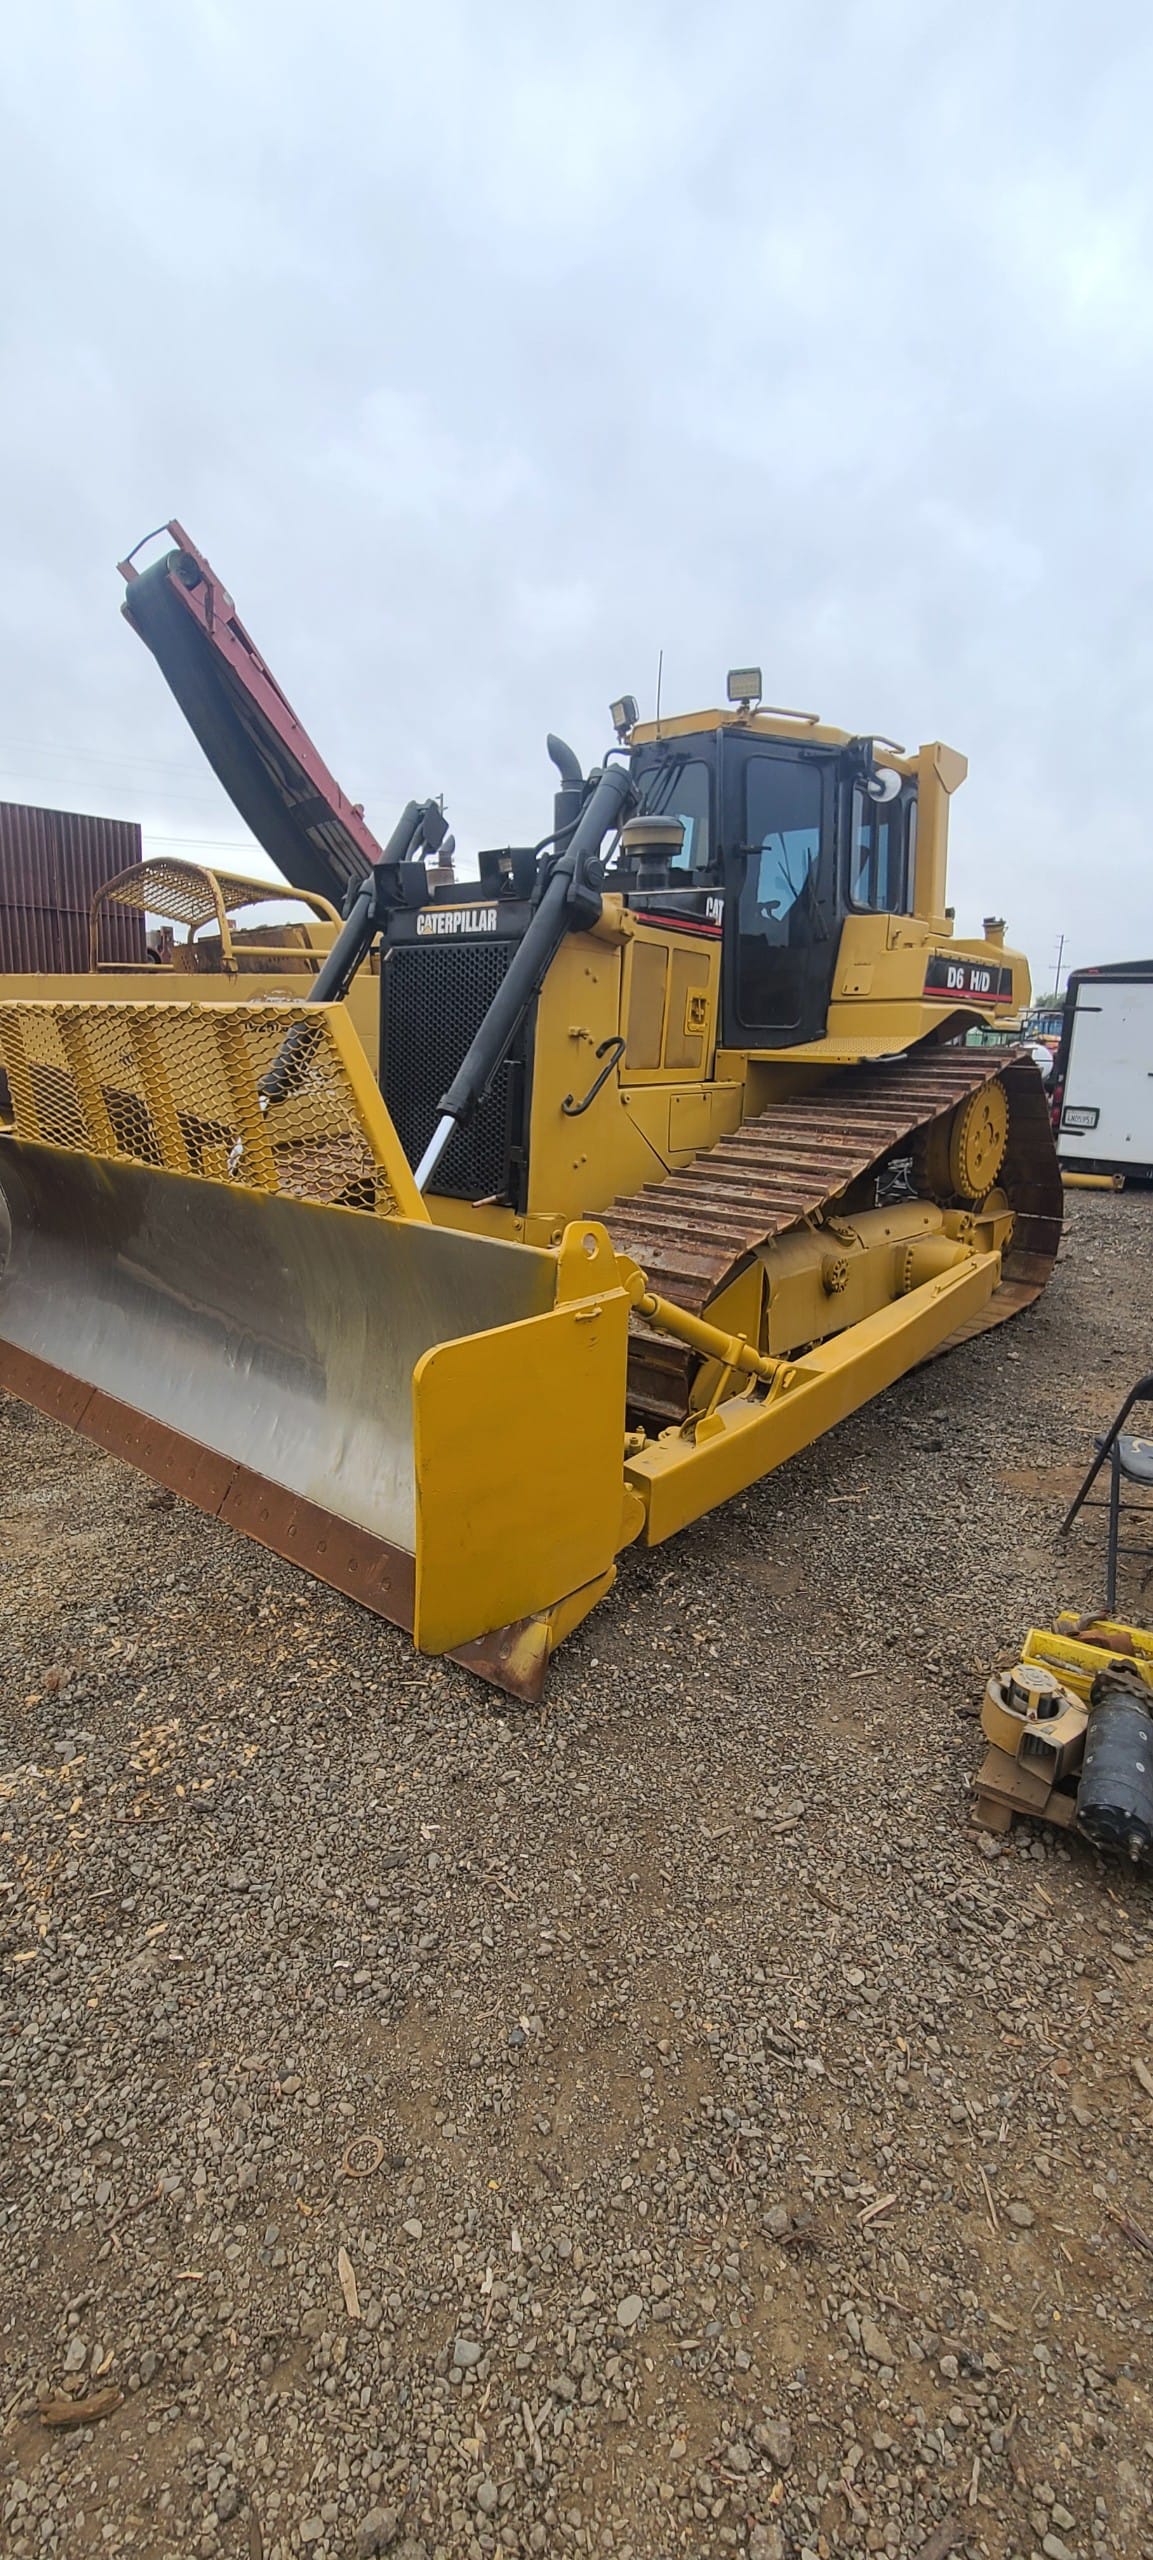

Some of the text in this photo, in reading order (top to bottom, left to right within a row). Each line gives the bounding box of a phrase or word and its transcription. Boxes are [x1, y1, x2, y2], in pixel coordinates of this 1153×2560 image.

[417, 909, 497, 935] CATERPILLAR
[705, 896, 725, 926] CAT
[947, 966, 990, 992] D6 H/D
